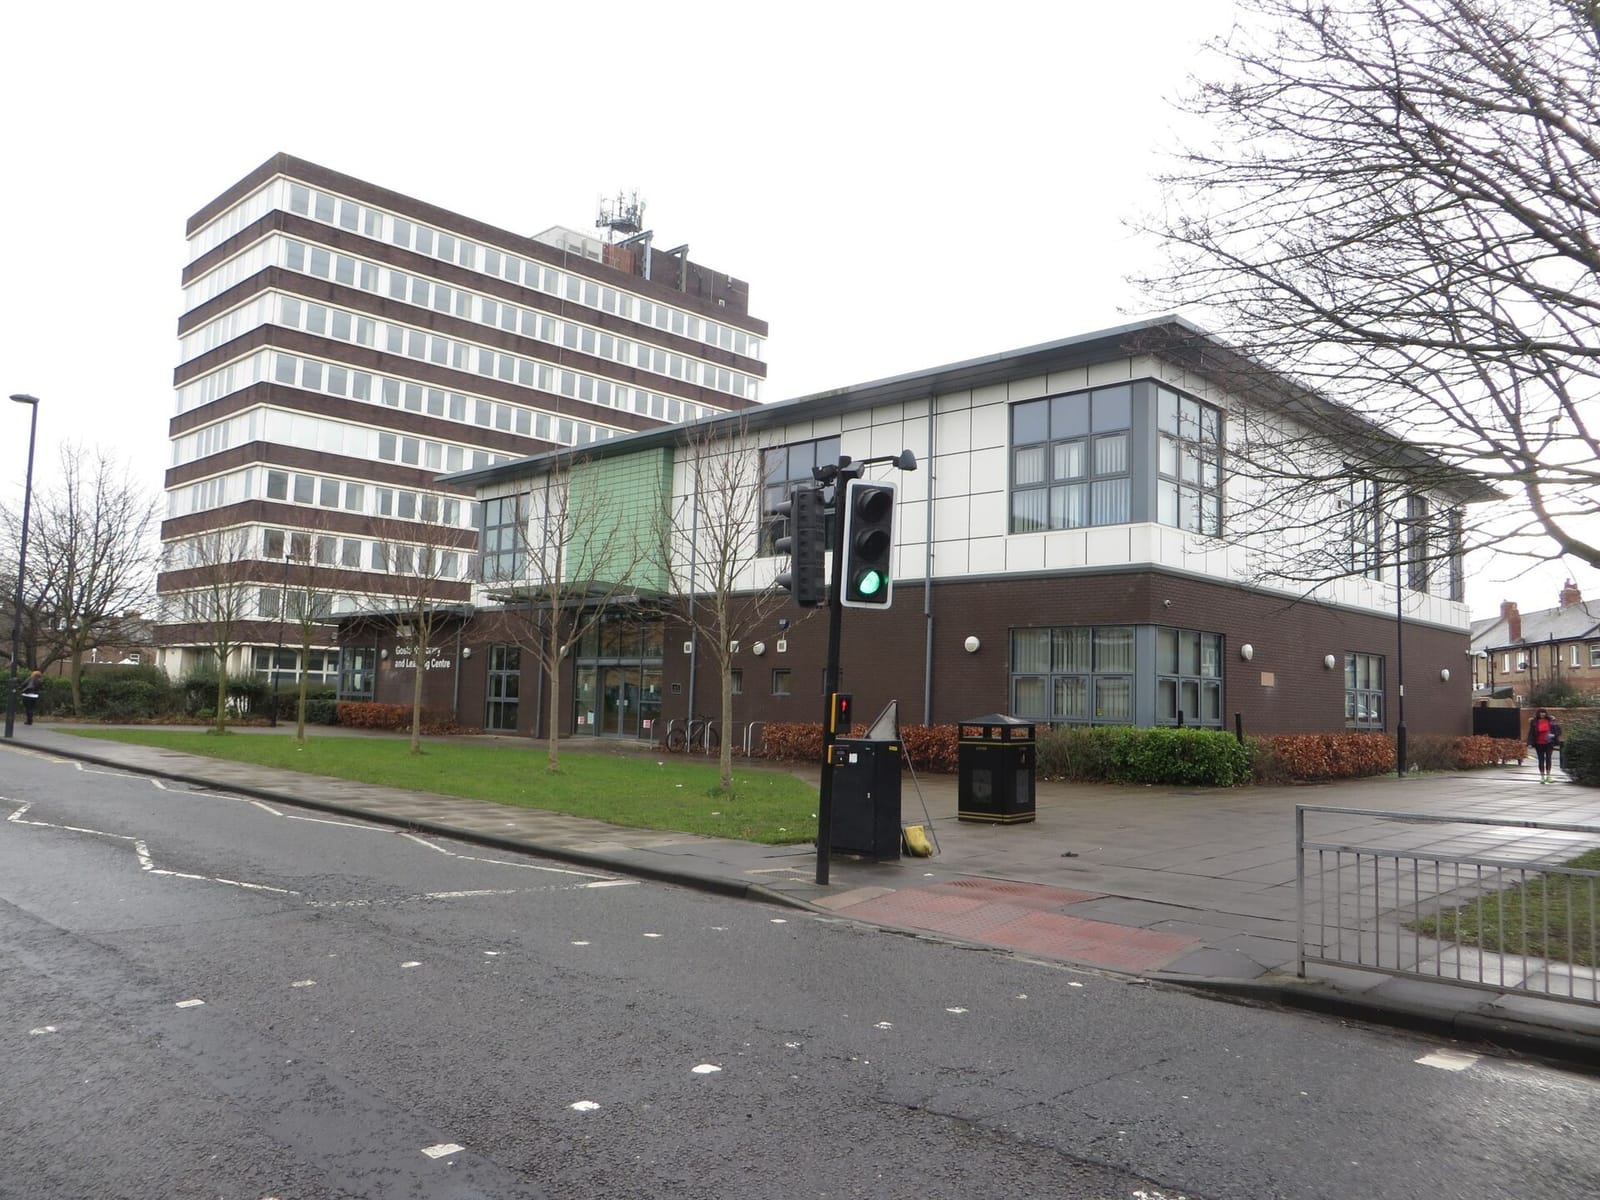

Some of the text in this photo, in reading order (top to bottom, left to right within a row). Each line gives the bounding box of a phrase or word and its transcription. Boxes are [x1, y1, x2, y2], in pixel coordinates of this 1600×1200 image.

[394, 658, 451, 671] and Leang Centre
